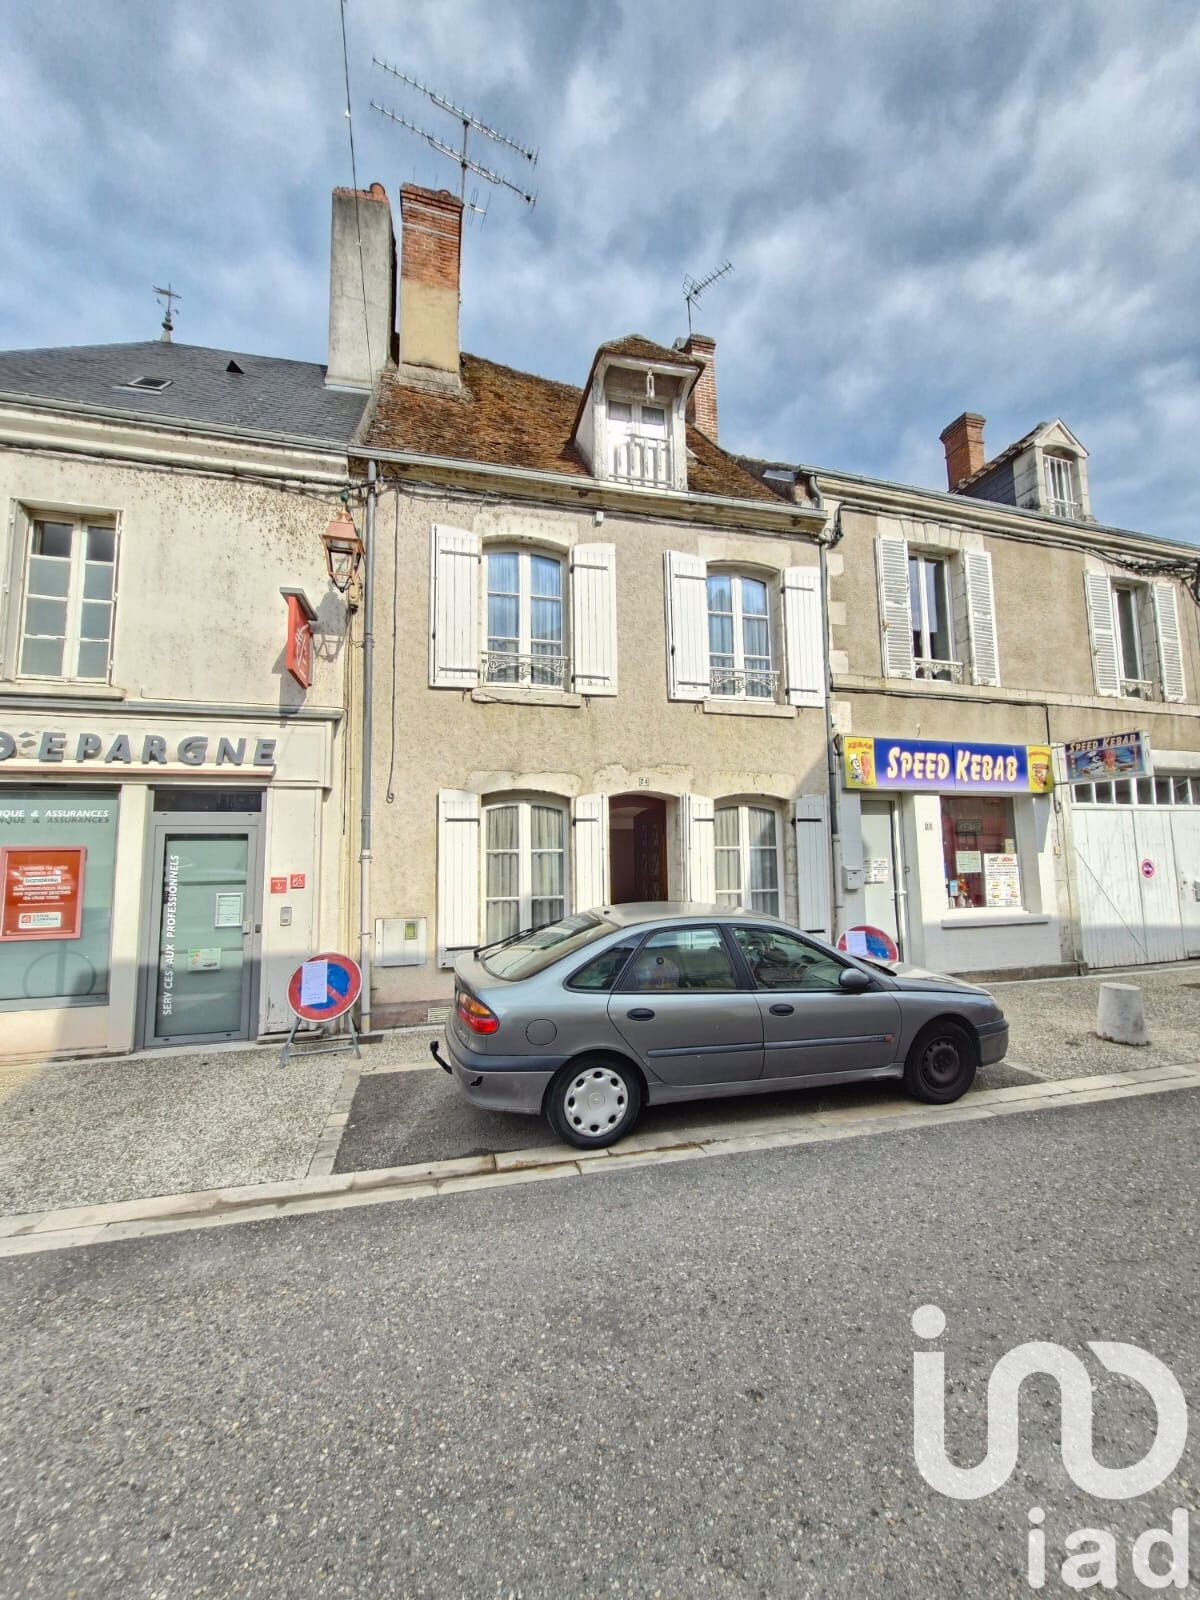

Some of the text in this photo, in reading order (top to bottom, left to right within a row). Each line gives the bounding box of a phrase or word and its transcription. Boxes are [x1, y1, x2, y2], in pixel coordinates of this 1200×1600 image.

[45, 809, 110, 818] ASSURANCES
[163, 855, 180, 1015] SERVCES AUX PROFESSIONNELS
